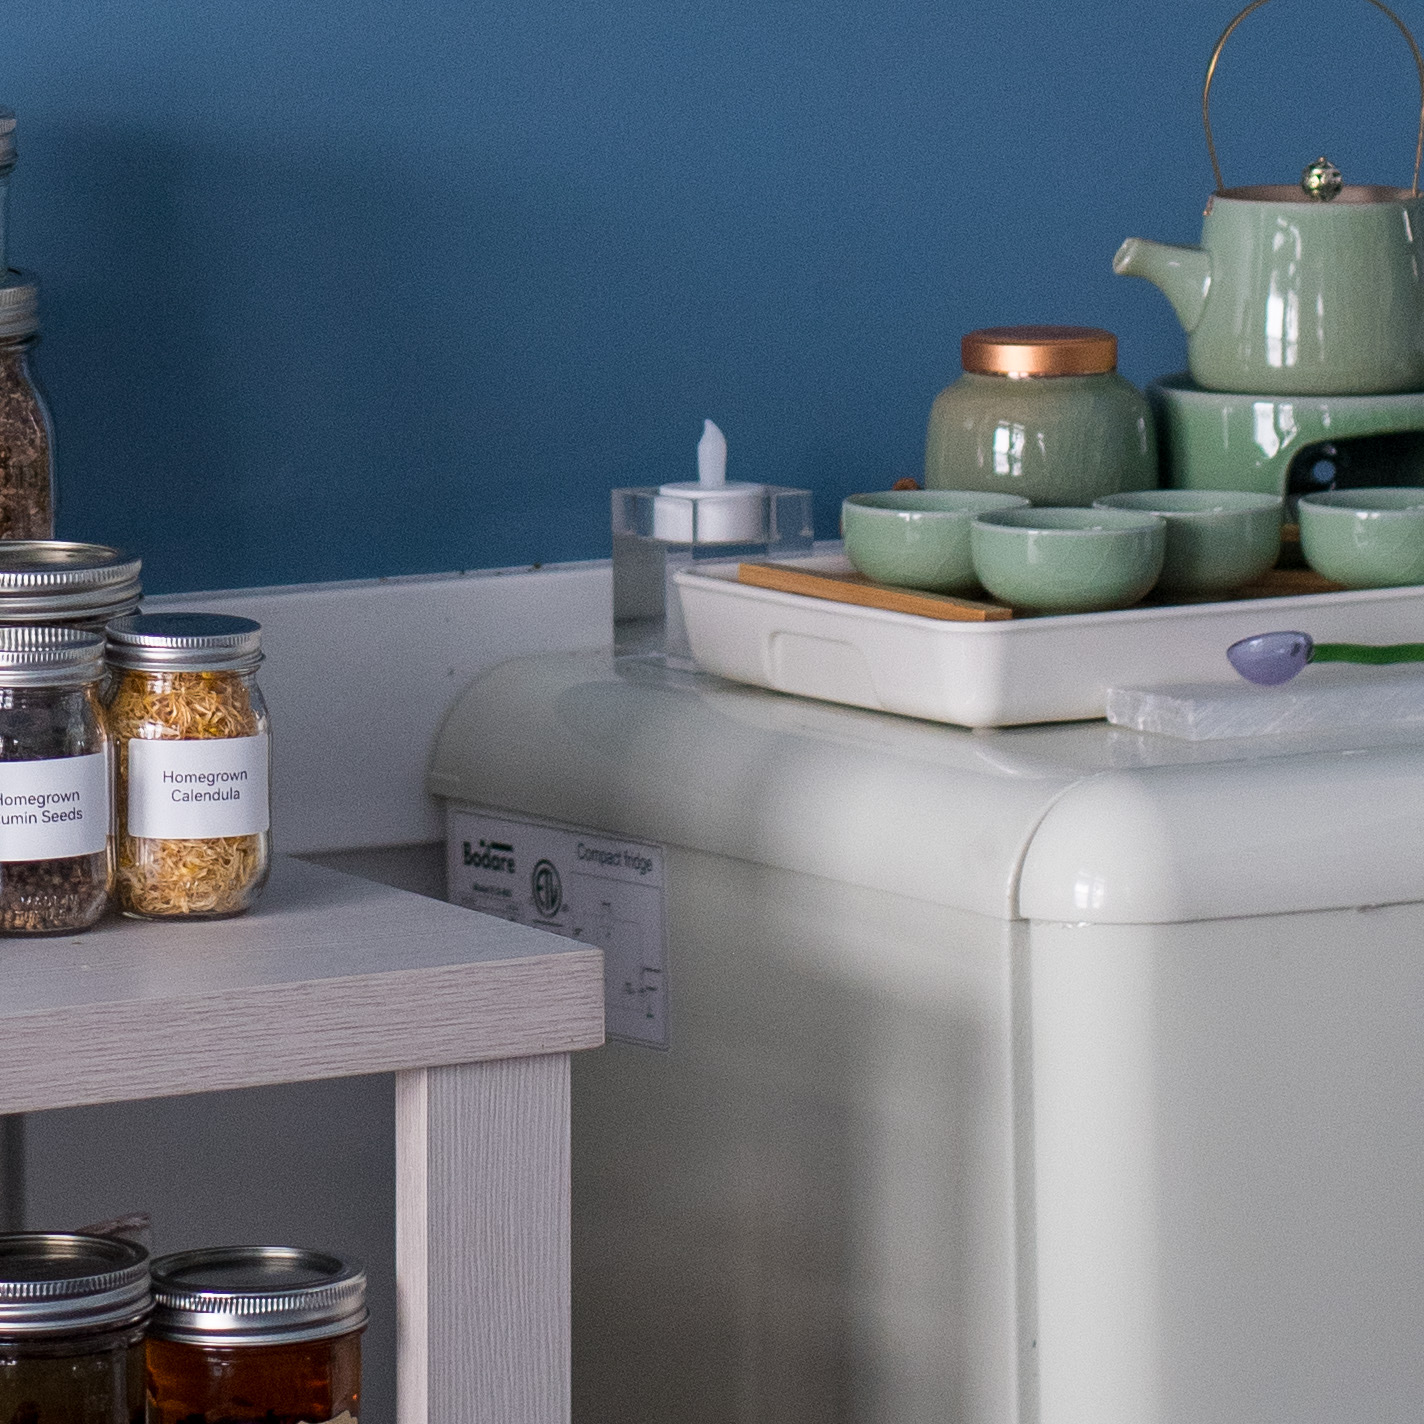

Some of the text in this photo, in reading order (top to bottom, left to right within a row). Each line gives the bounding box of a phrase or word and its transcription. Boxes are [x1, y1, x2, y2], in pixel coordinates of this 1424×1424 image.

[163, 770, 248, 786] Homegrown
[171, 787, 241, 802] Calendula
[42, 807, 83, 824] Seeds
[577, 842, 653, 876] Compact fridge
